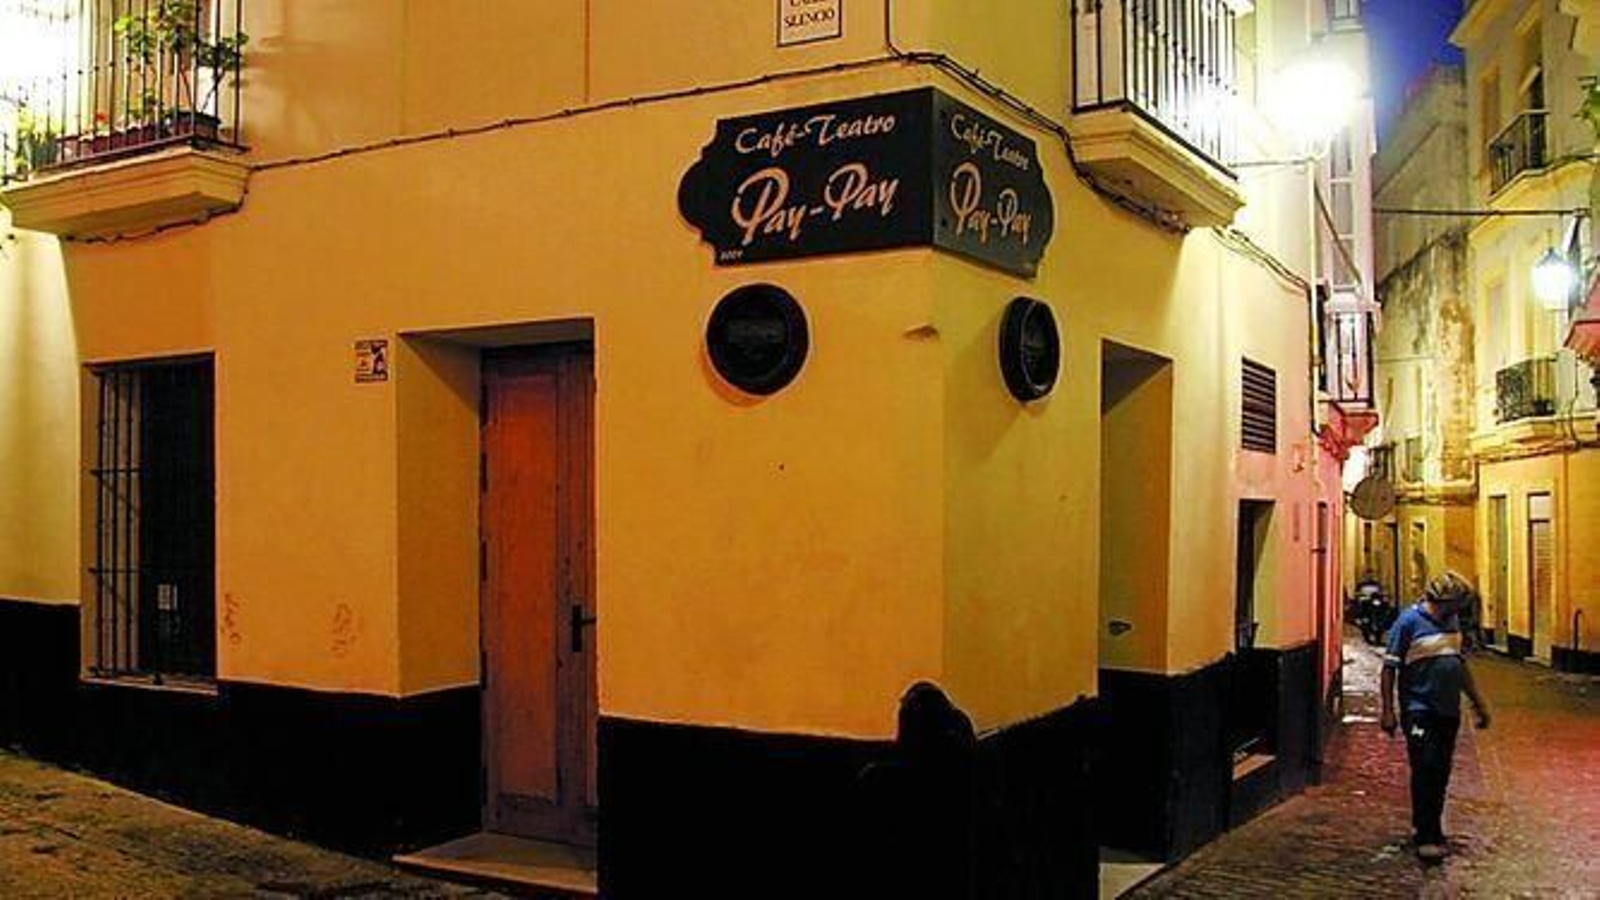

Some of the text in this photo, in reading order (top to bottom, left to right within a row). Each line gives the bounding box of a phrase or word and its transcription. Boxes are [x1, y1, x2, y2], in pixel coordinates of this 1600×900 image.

[734, 114, 896, 158] Café-Teatro
[731, 162, 899, 246] Pay-Pay
[950, 161, 1032, 244] Pay-Pay
